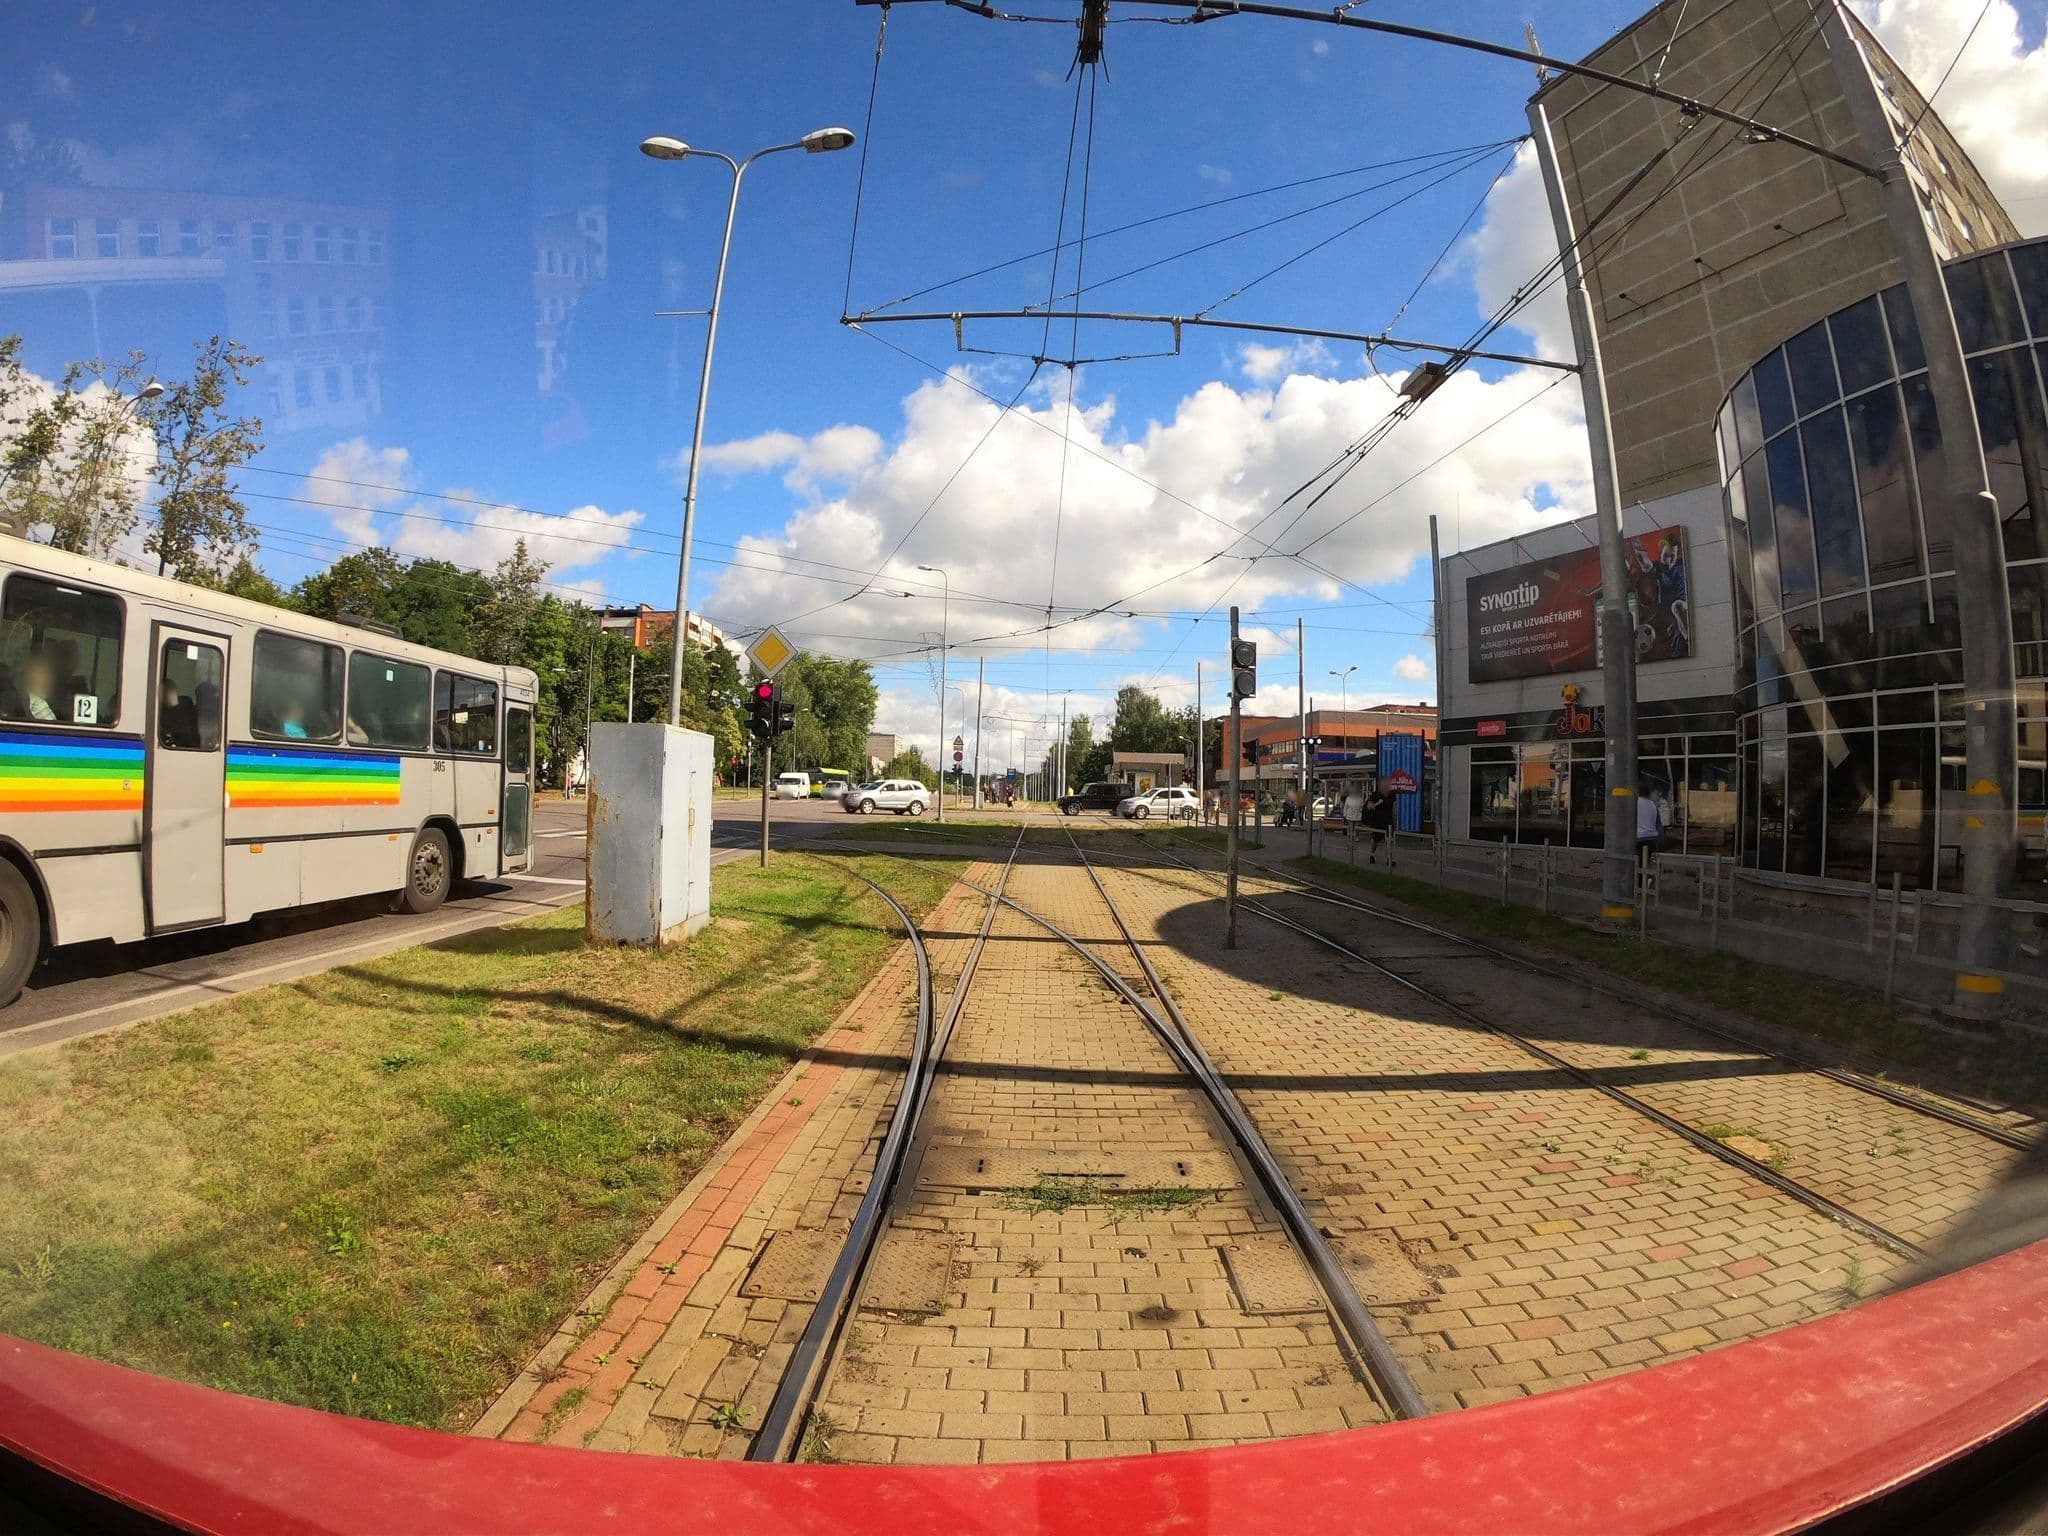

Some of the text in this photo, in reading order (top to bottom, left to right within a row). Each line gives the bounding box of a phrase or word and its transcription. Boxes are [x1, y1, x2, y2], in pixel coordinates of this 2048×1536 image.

[1480, 609, 1583, 635] ESI KOPĀ AR UZVARĒTĀJIEM!
[1510, 635, 1529, 645] SPORTA
[1522, 645, 1531, 654] UN
[1530, 643, 1552, 653] SPORTA
[1553, 640, 1569, 650] BĀRĀ
[77, 699, 91, 718] 12
[1556, 703, 1605, 737] Jok
[433, 761, 446, 772] 305
